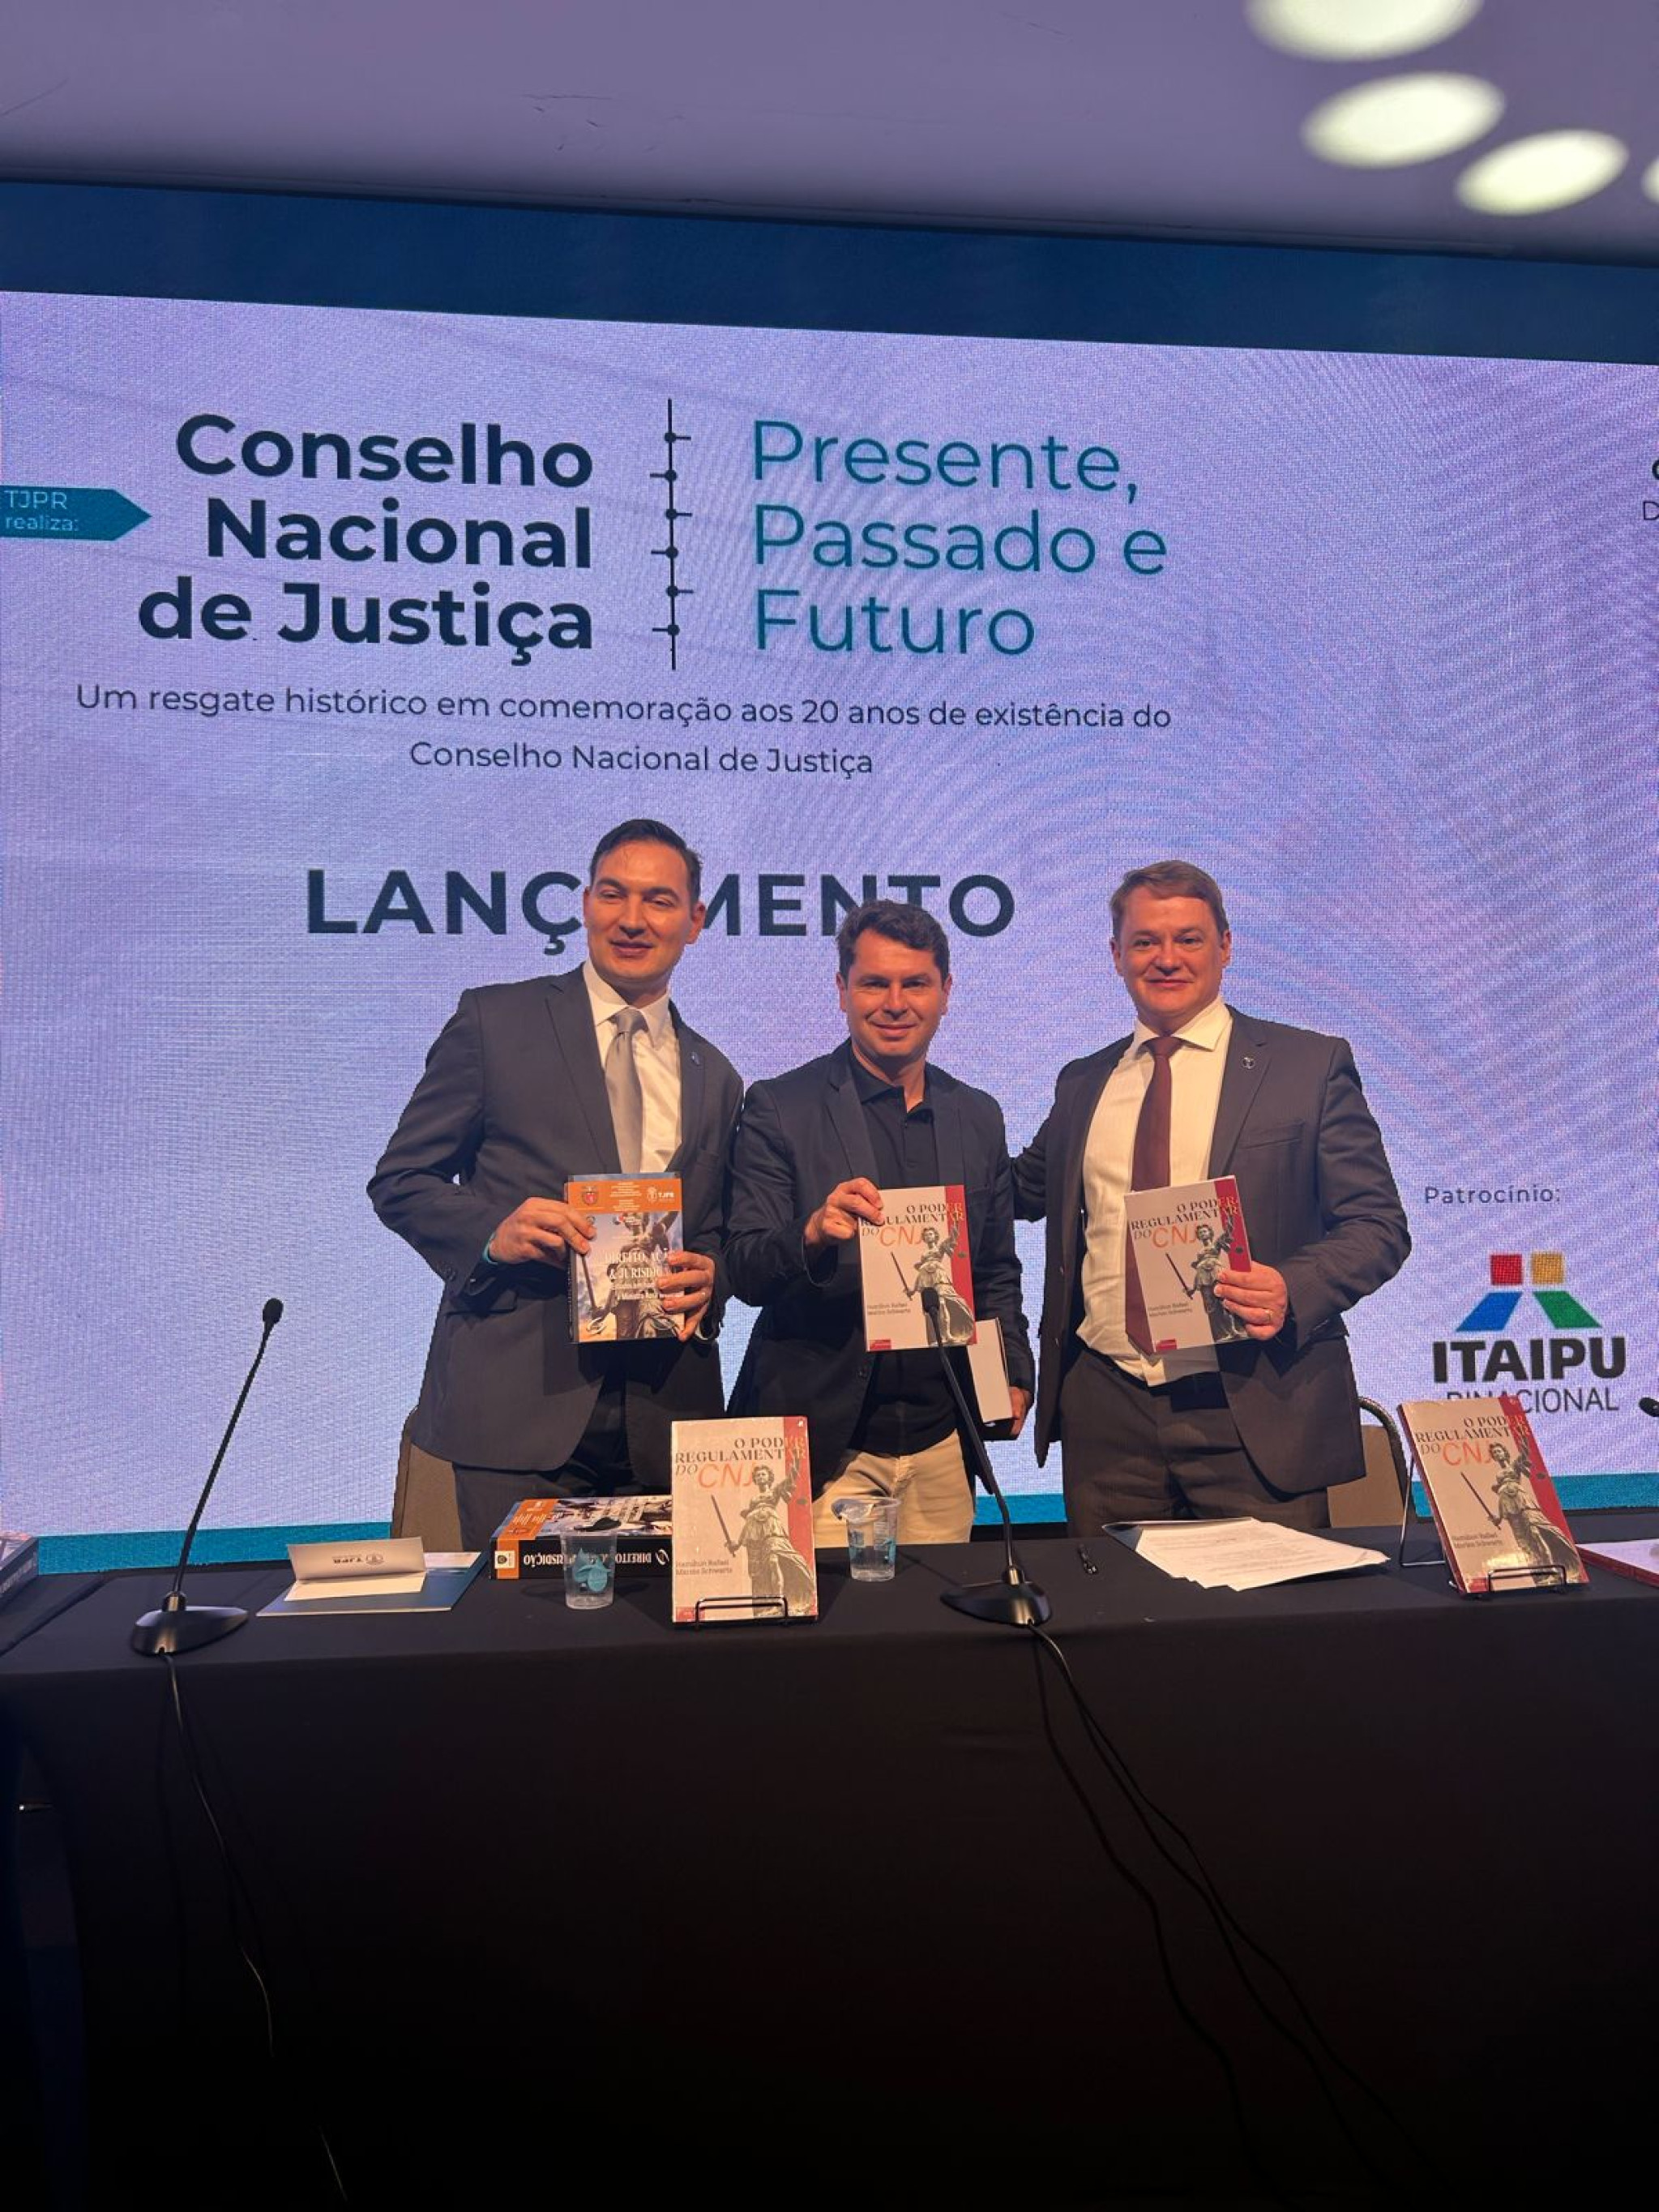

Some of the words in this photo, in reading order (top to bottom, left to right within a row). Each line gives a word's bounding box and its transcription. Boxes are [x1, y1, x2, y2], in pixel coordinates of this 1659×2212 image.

[176, 413, 592, 488] Conselho
[754, 419, 1138, 503] Presente,
[4, 490, 67, 509] TJPR
[6, 515, 79, 532] realiza:
[207, 497, 591, 568] Nacional
[755, 504, 1097, 573] Passado
[1122, 527, 1167, 575] e
[139, 576, 252, 640] de
[277, 582, 592, 666] Justiça
[757, 588, 1036, 656] Futuro
[77, 684, 137, 710] Um
[149, 690, 276, 718] resgate
[286, 687, 427, 716] histórico
[437, 696, 490, 717] em
[499, 696, 732, 728] comemoração
[741, 704, 793, 723] aos
[802, 699, 839, 725] 20
[849, 705, 920, 725] anos
[929, 701, 967, 726] de
[976, 701, 1124, 728] existência
[1133, 703, 1171, 729] do
[410, 742, 562, 768] Conselho
[573, 746, 709, 772] Nacional
[719, 747, 759, 772] de
[767, 747, 873, 780] Justiça
[307, 869, 1015, 956] LANÇMENTO
[1425, 1184, 1560, 1204] Patrocínio:
[906, 1204, 915, 1213] O
[1177, 1204, 1186, 1213] O
[862, 1227, 879, 1237] DO
[1135, 1230, 1151, 1239] DO
[1433, 1337, 1626, 1384] ITAIPU
[1464, 1417, 1474, 1427] O
[733, 1438, 745, 1448] O
[1421, 1443, 1440, 1455] DO
[676, 1465, 699, 1476] DO
